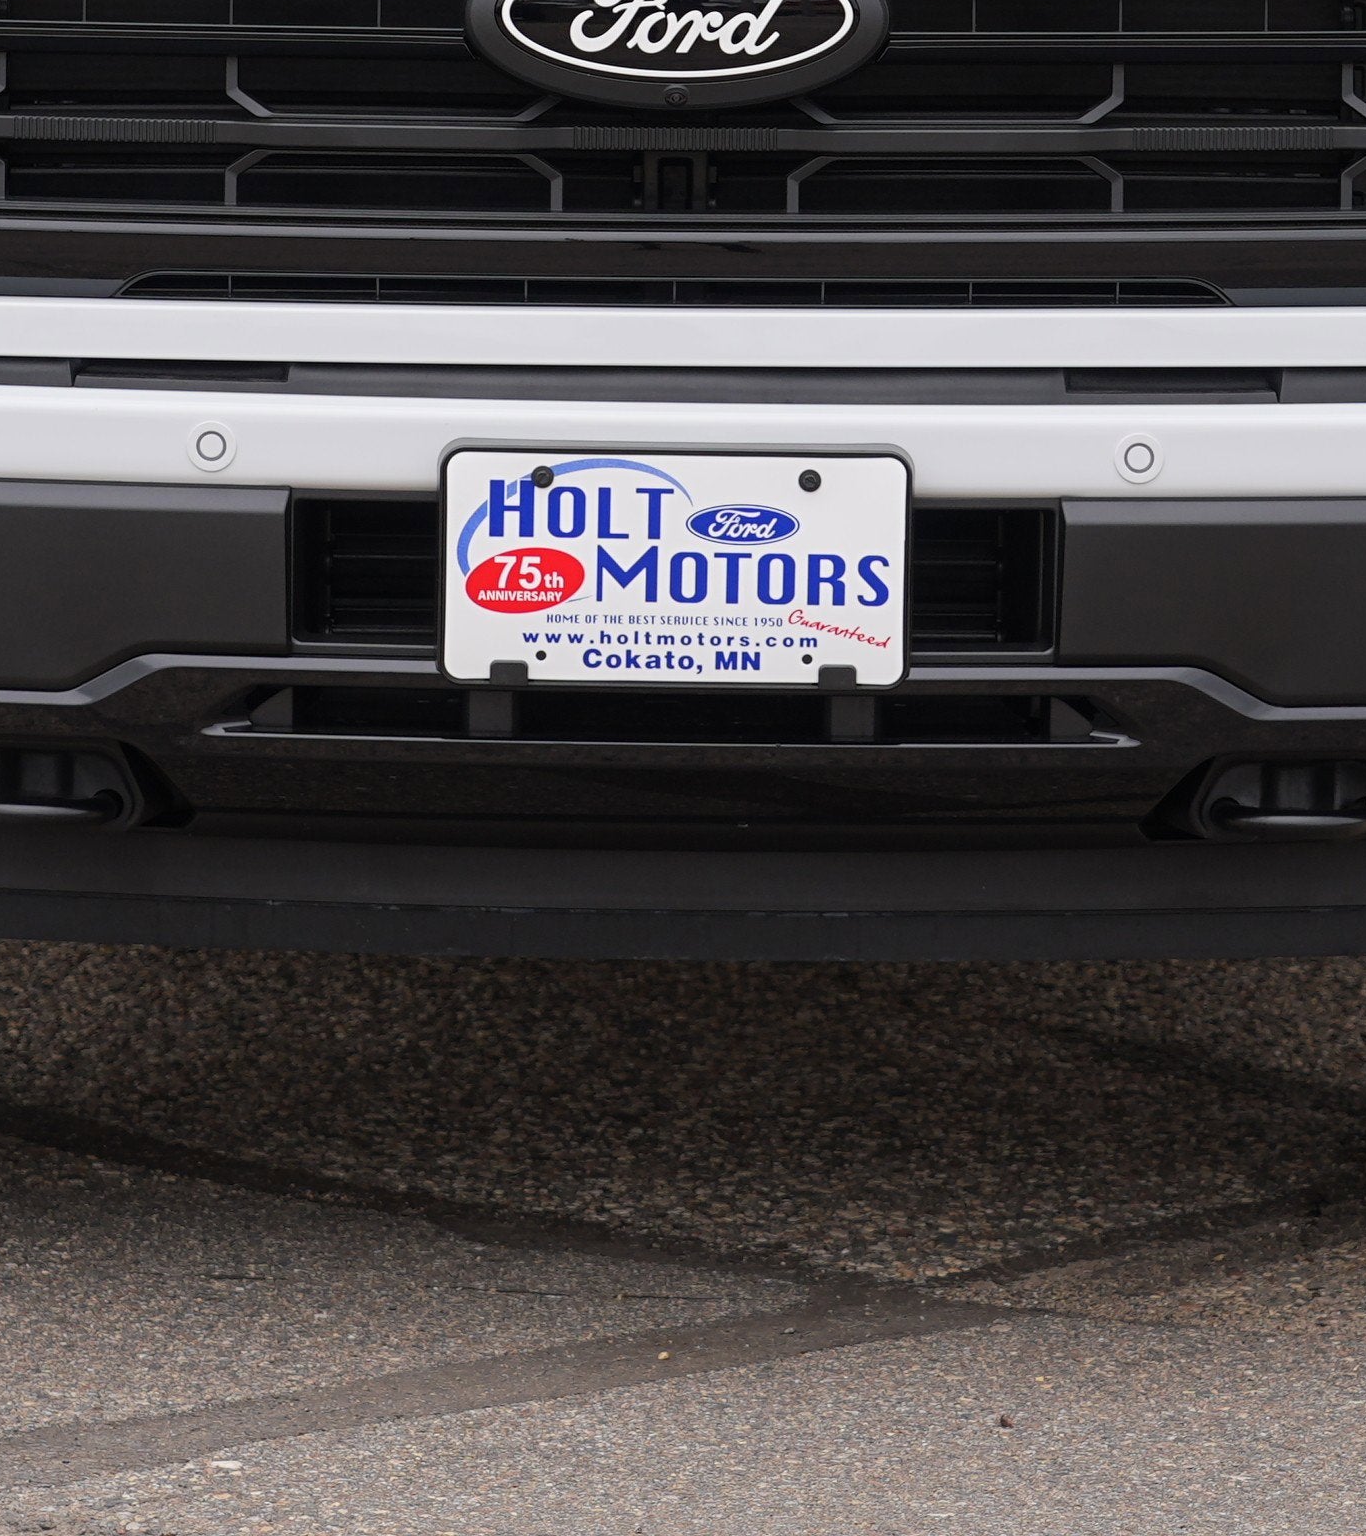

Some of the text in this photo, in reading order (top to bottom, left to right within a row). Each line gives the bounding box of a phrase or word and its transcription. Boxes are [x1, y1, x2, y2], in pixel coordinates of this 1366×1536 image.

[488, 479, 675, 540] HOLT
[707, 509, 778, 539] Ford
[493, 555, 565, 590] 75th
[595, 544, 890, 607] MOTORS
[477, 590, 563, 602] ANNIVERSARY
[546, 613, 783, 627] HOME OF THE BEST SERVICE SINCE 1950
[788, 609, 891, 648] Guaranteed
[522, 630, 818, 648] www.holtmotors.com
[582, 648, 761, 674] Cokato, MN
